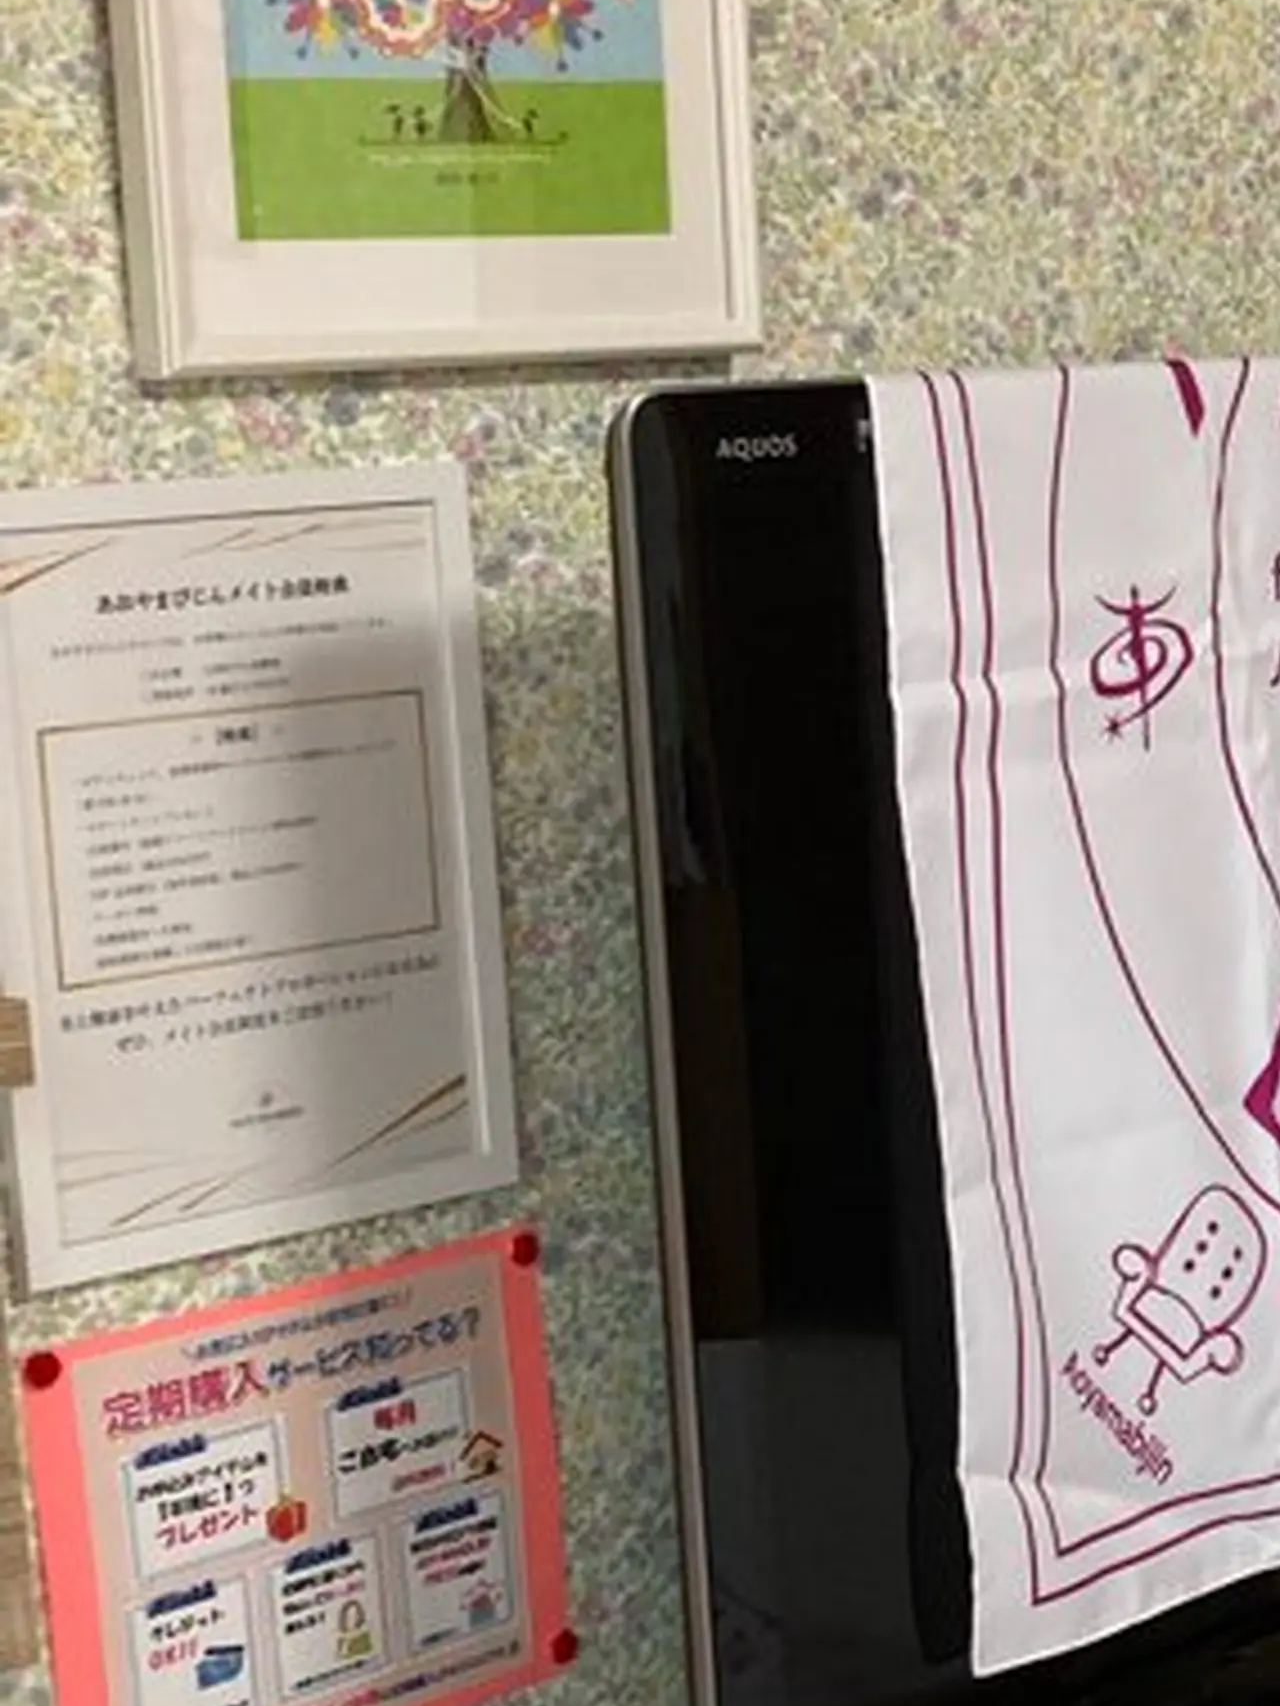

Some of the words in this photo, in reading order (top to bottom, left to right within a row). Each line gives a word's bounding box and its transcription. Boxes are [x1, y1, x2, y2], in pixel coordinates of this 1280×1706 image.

[715, 432, 799, 463] AQUOS
[1060, 1348, 1175, 1486] Aoyamabijin
[154, 1503, 264, 1549] プレゼント
